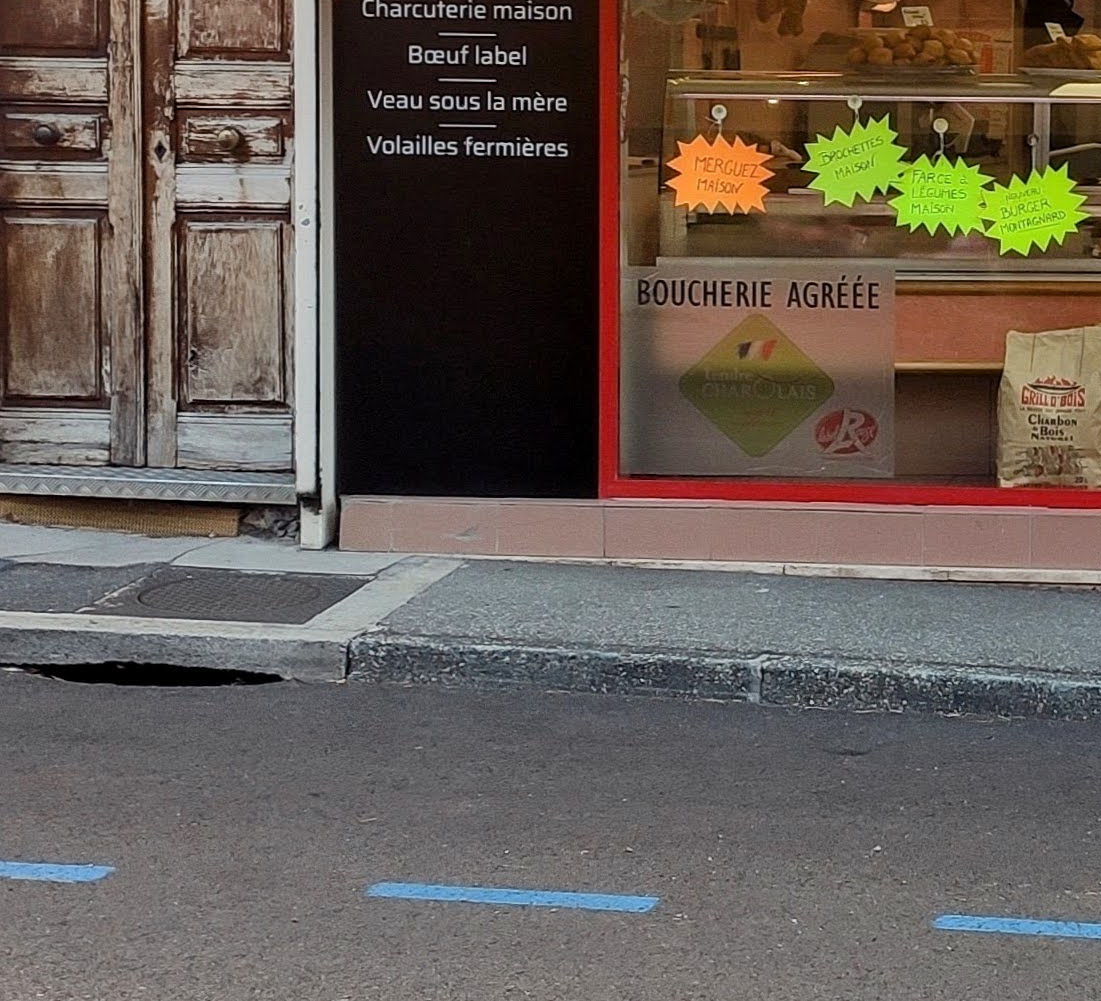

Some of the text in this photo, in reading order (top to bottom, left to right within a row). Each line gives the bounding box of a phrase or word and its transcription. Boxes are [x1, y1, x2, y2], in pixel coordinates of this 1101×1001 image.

[493, 0, 573, 21] maison
[408, 44, 528, 66] Bœuf label
[367, 90, 568, 113] Veau sous la mère
[367, 135, 569, 158] Volailles fermières
[819, 135, 884, 167] BROCHETTES
[694, 155, 760, 179] MERGUEZ
[834, 153, 876, 181] MAISON
[912, 169, 952, 185] FARCE
[696, 177, 745, 194] MAISON
[911, 201, 955, 215] MAISON
[1000, 199, 1052, 220] BURGER
[1000, 211, 1067, 234] MONTAGNARD
[637, 275, 880, 309] BOUCHERIE AGRÉÉE
[1040, 426, 1065, 436] Bois
